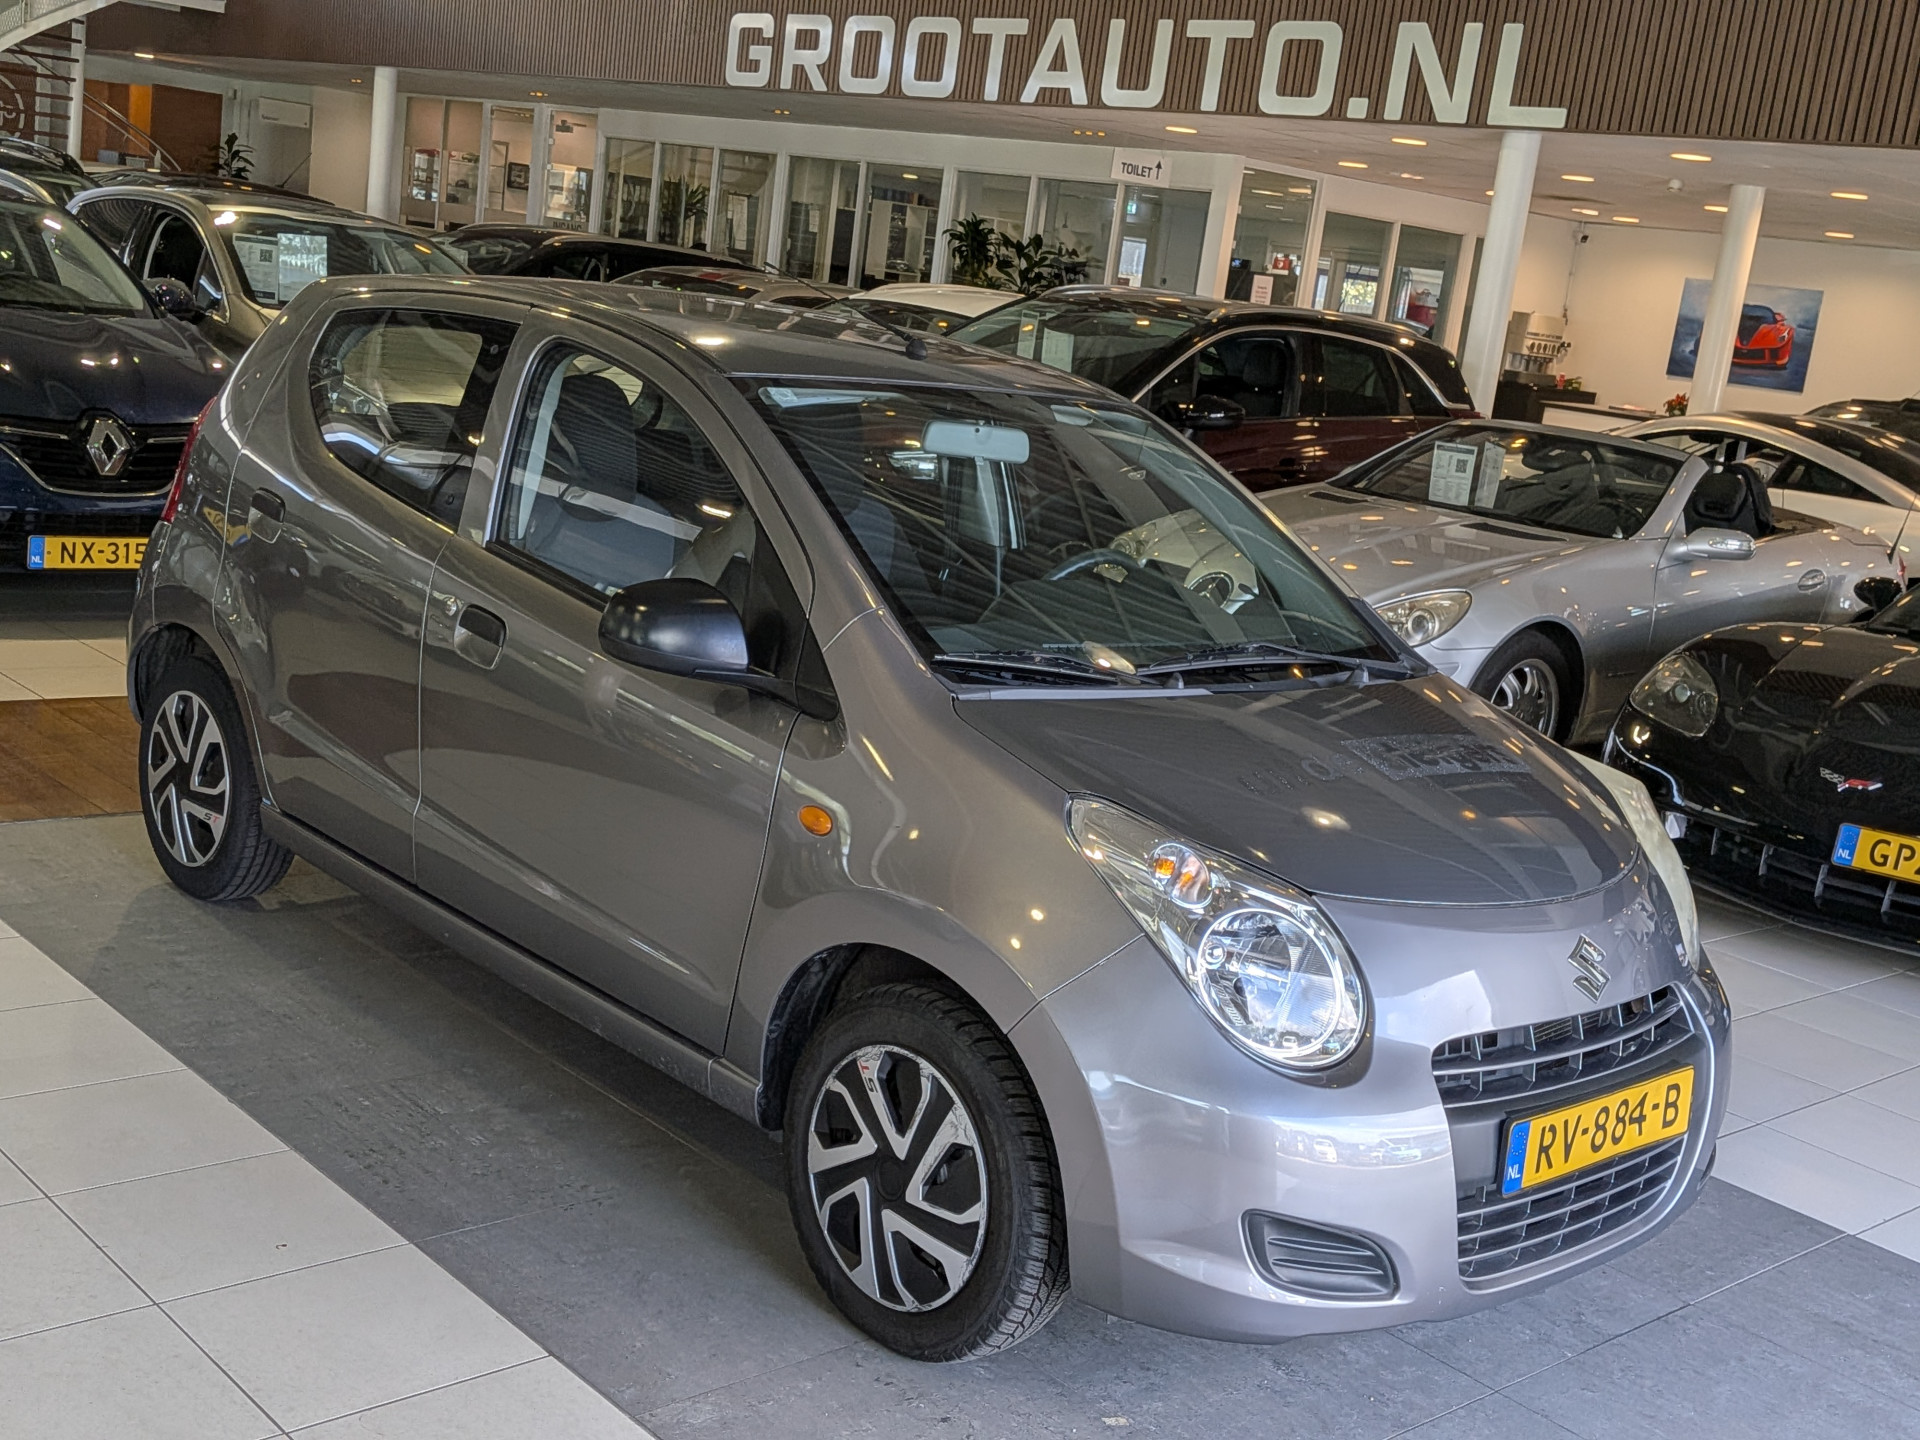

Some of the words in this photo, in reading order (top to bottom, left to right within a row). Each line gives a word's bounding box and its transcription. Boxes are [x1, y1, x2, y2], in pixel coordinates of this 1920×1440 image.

[725, 12, 1568, 129] GROOTAUTO.NL
[1121, 162, 1153, 179] TOILET
[204, 813, 220, 823] ST
[1838, 848, 1851, 859] NL
[1869, 838, 1920, 876] GP
[859, 1061, 878, 1093] ST
[1507, 1164, 1520, 1180] NL
[1535, 1083, 1680, 1174] RV-884-B
